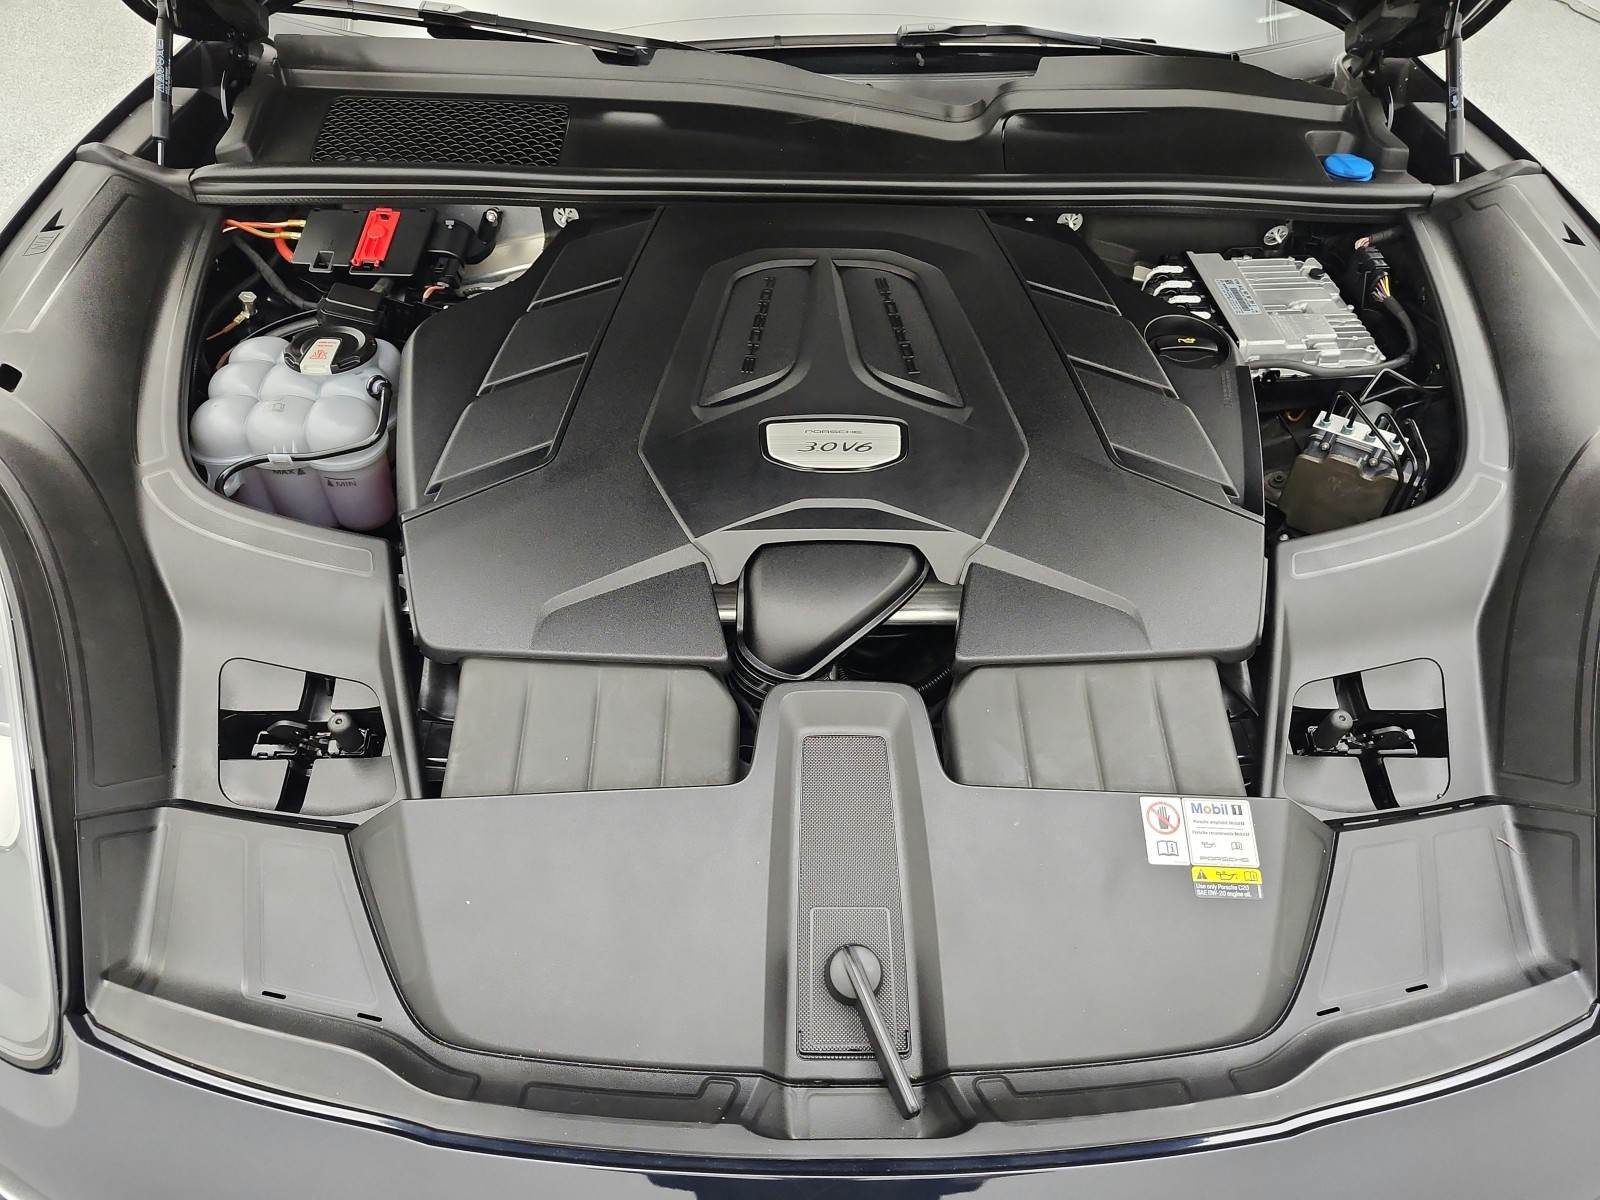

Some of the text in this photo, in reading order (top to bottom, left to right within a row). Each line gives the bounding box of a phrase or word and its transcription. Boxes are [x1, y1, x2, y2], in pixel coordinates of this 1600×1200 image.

[741, 277, 776, 373] PORSCHE
[875, 278, 921, 374] PORSCHE
[842, 441, 872, 452] V6
[1190, 802, 1243, 815] Mobil 1
